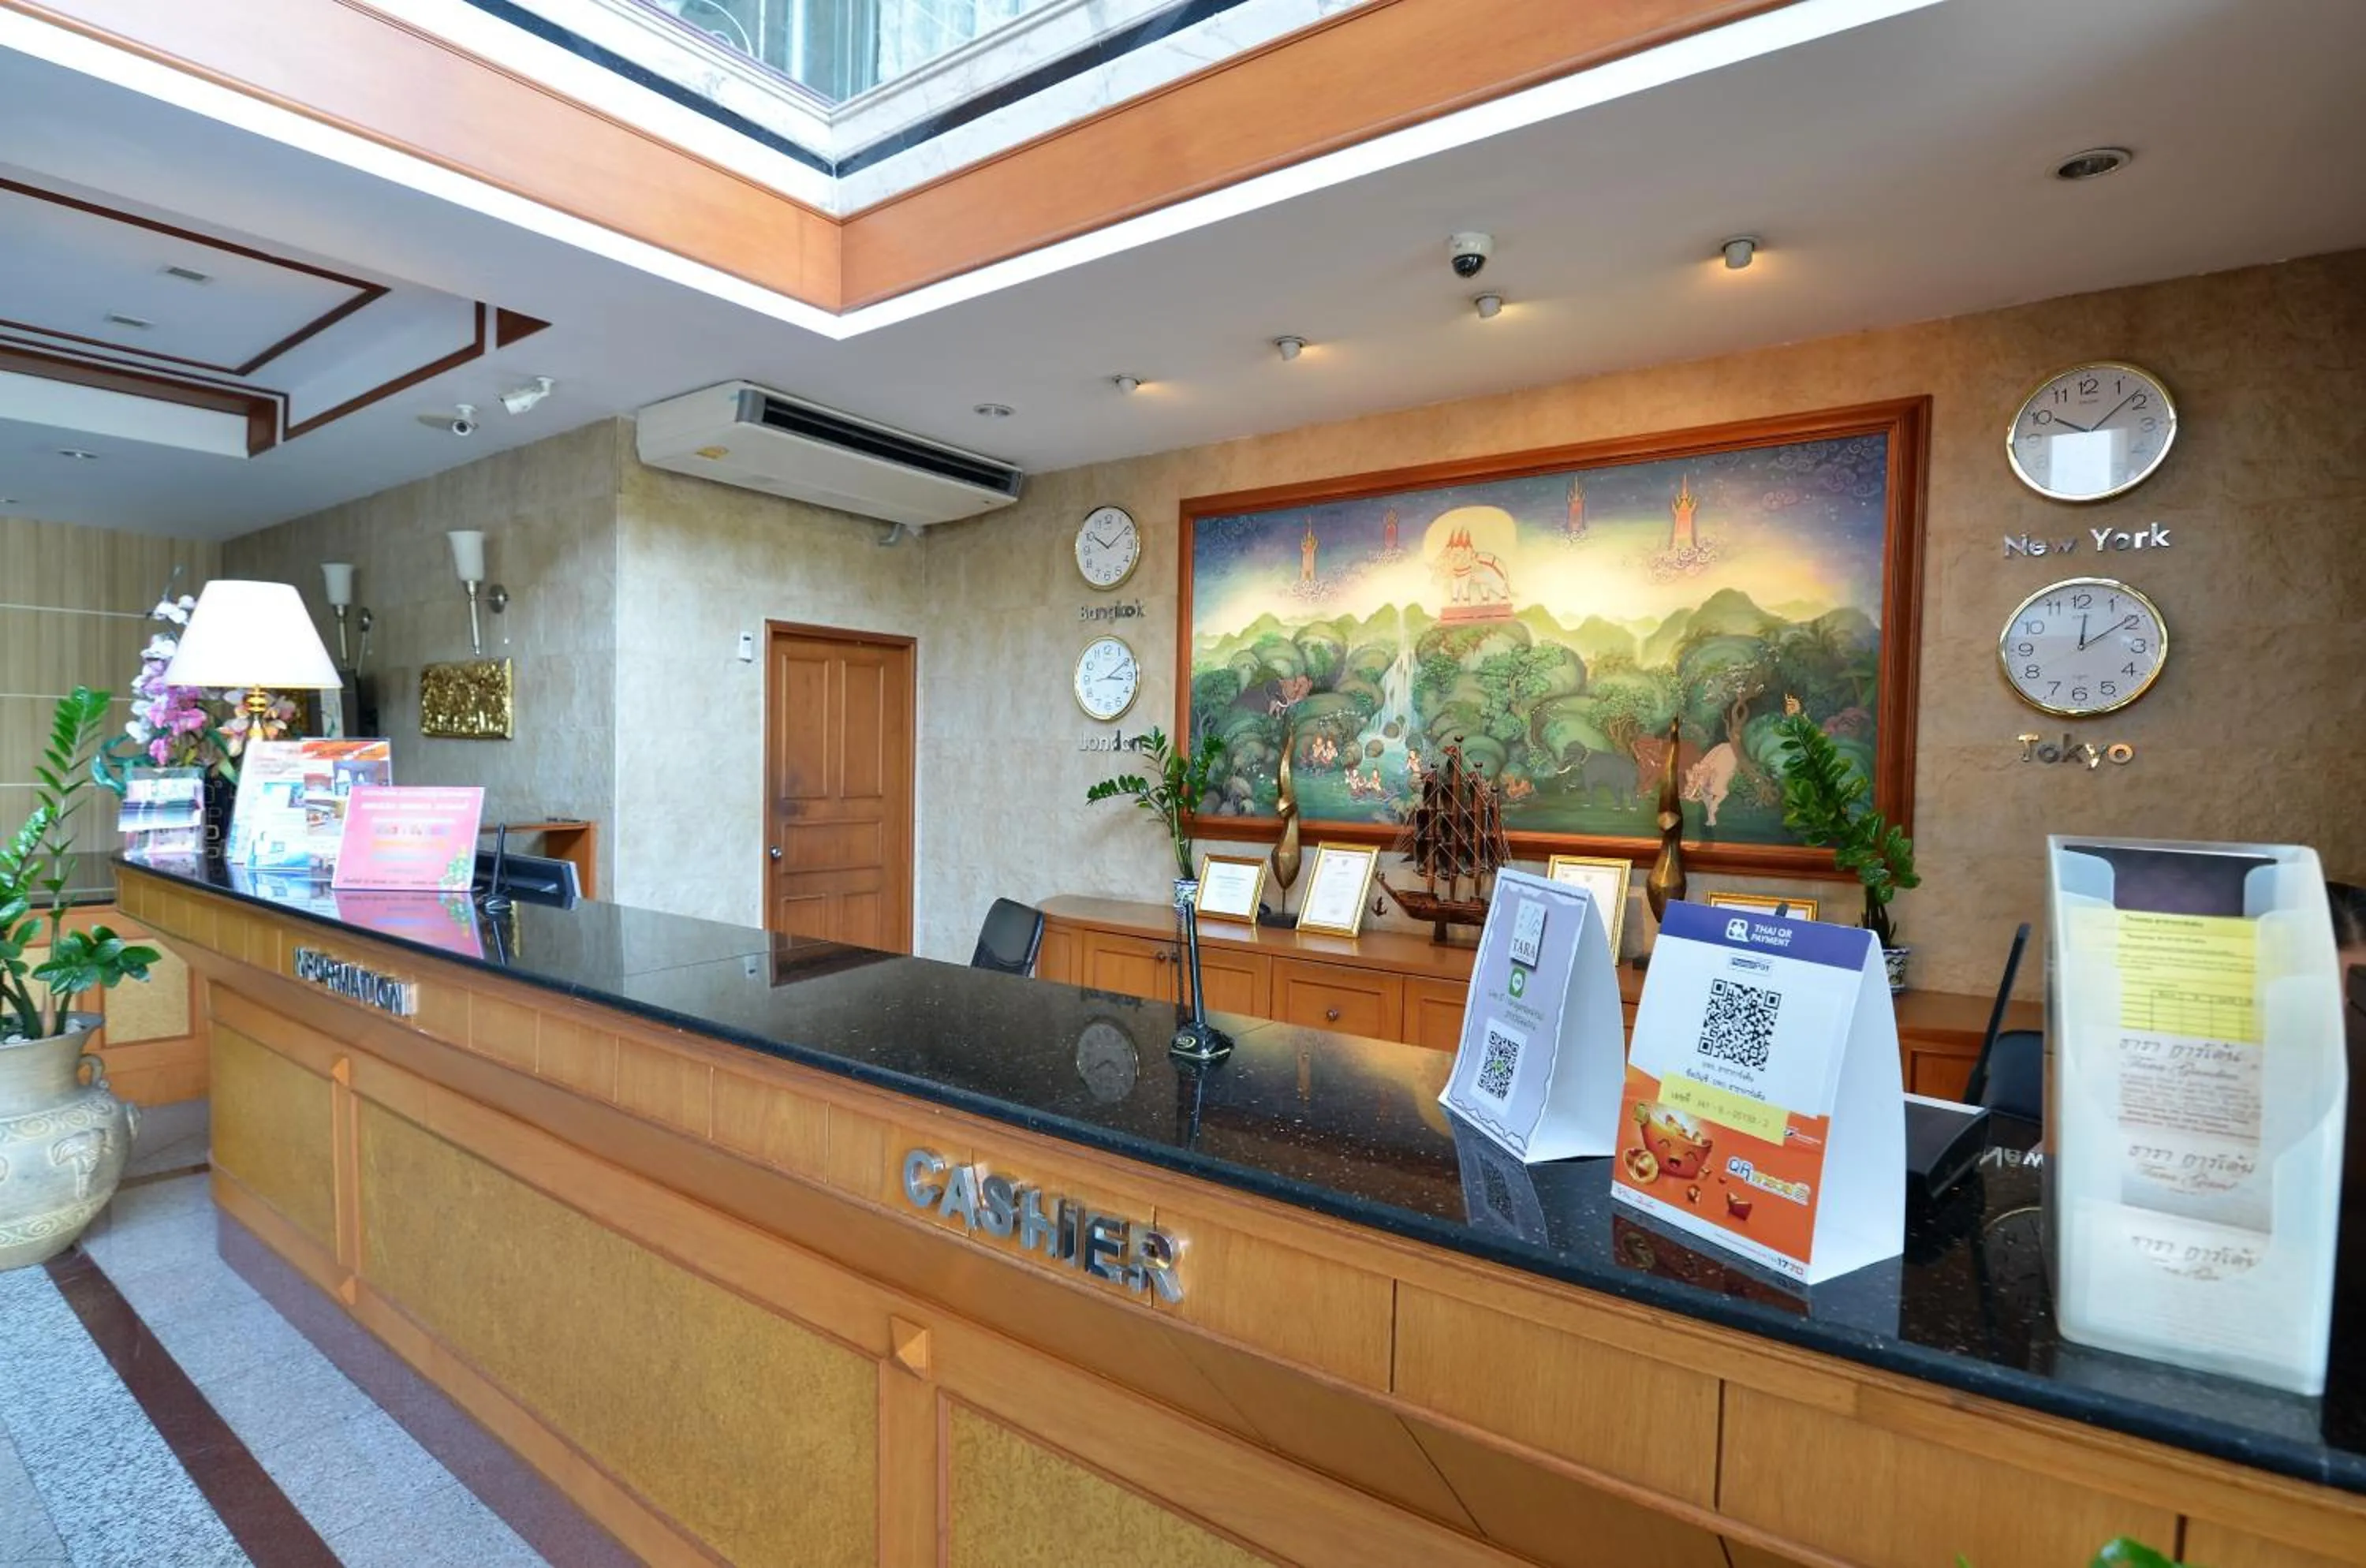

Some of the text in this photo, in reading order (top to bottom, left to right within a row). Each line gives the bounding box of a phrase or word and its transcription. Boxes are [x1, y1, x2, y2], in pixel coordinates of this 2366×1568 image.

[2079, 378, 2099, 395] 12
[2114, 379, 2121, 394] 1
[2054, 388, 2068, 404] 11
[2132, 394, 2147, 411] 2
[2032, 409, 2053, 426] 10
[2140, 417, 2156, 433] 3
[2004, 521, 2170, 557] New York
[2047, 601, 2061, 616] 11
[2071, 594, 2092, 609] 12
[2109, 598, 2115, 612] 1
[2025, 620, 2045, 634] 10
[2125, 614, 2140, 630] 2
[2018, 643, 2034, 657] 9
[2130, 638, 2146, 654] 3
[2025, 664, 2040, 679] 8
[2121, 661, 2136, 677] 4
[2047, 681, 2061, 696] 7
[2072, 687, 2088, 701] 6
[2099, 681, 2116, 696] 5
[2017, 733, 2134, 771] Tokyo
[1755, 924, 1777, 936] THAI
[1751, 933, 1790, 946] PAYMENT
[1513, 938, 1536, 958] TARA
[903, 1147, 1185, 1304] CASHIER
